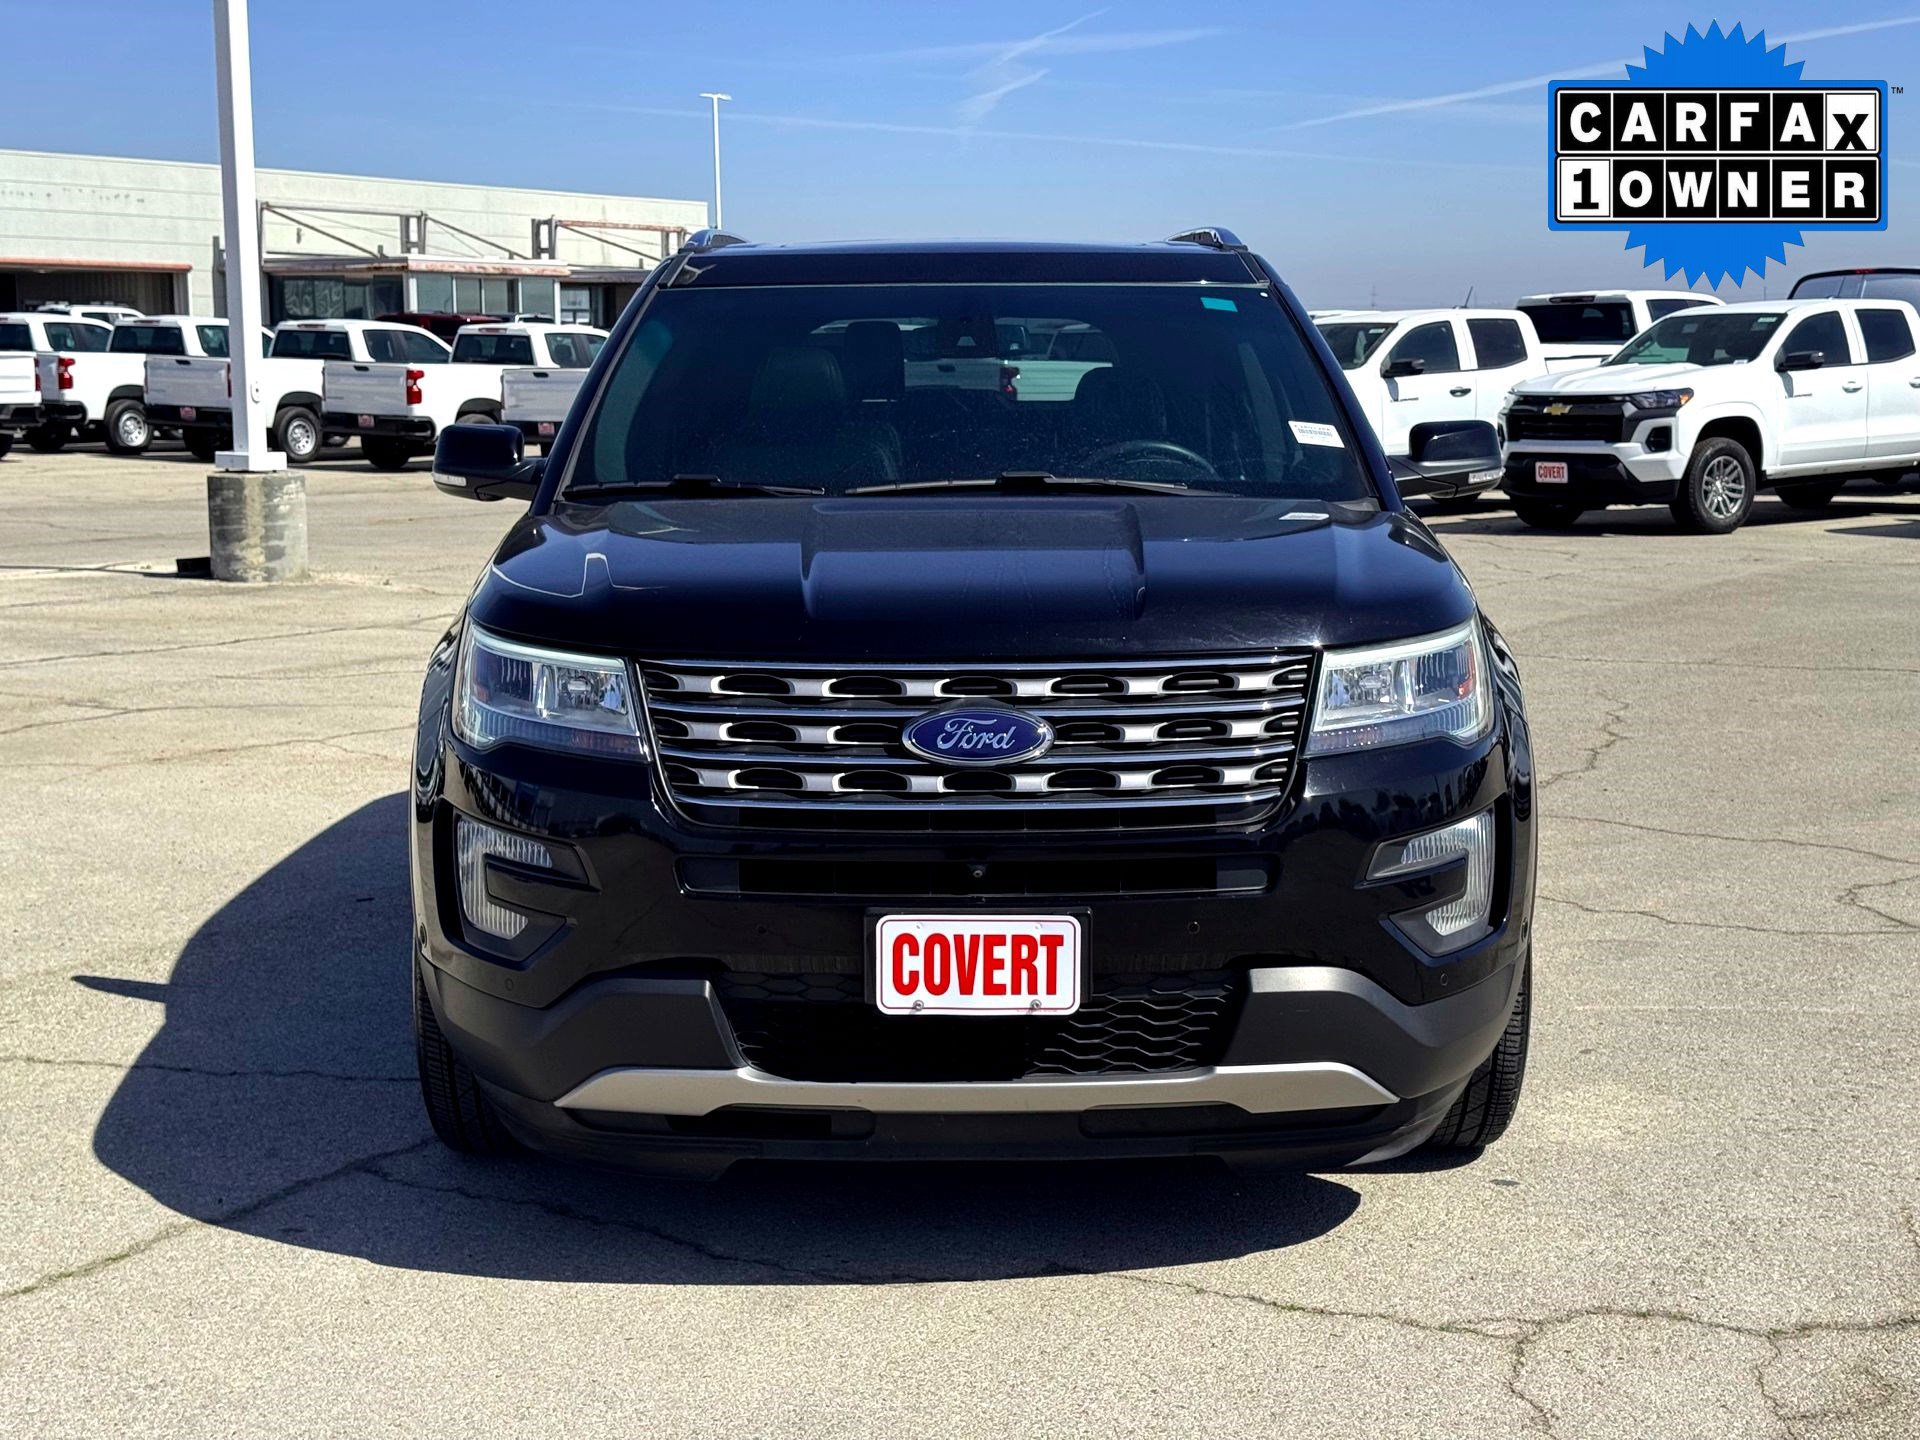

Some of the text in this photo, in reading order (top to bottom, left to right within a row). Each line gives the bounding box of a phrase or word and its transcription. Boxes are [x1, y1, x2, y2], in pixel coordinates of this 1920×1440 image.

[1538, 465, 1564, 478] COVERT
[936, 717, 1016, 750] Ford
[892, 932, 1064, 996] COVERT
